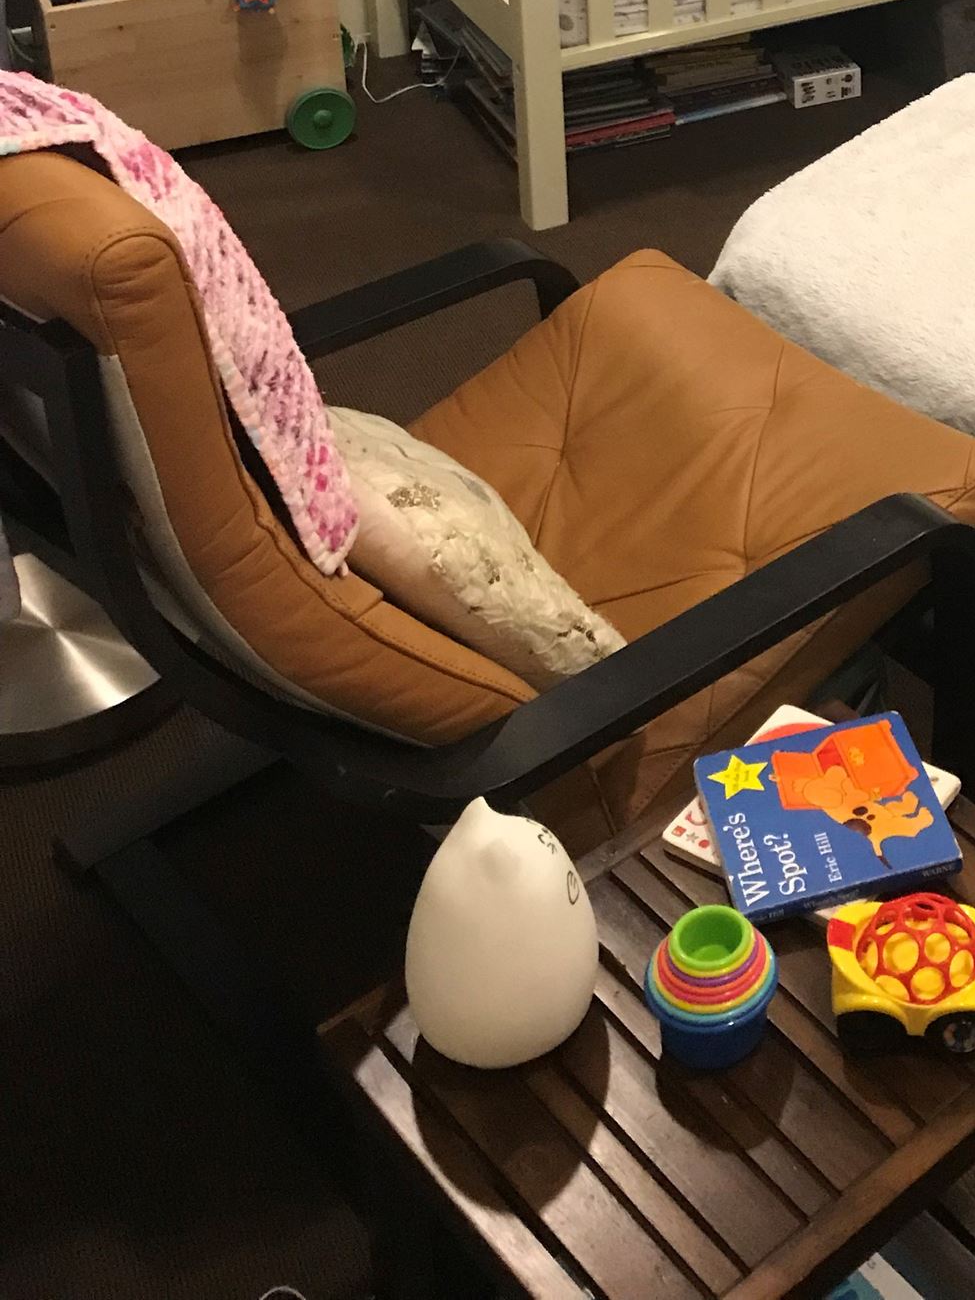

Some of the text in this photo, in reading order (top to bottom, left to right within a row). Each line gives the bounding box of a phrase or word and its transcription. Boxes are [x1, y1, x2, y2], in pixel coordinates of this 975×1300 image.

[723, 812, 770, 907] Where's
[763, 833, 808, 896] Spot?
[814, 832, 843, 883] Eric Hill
